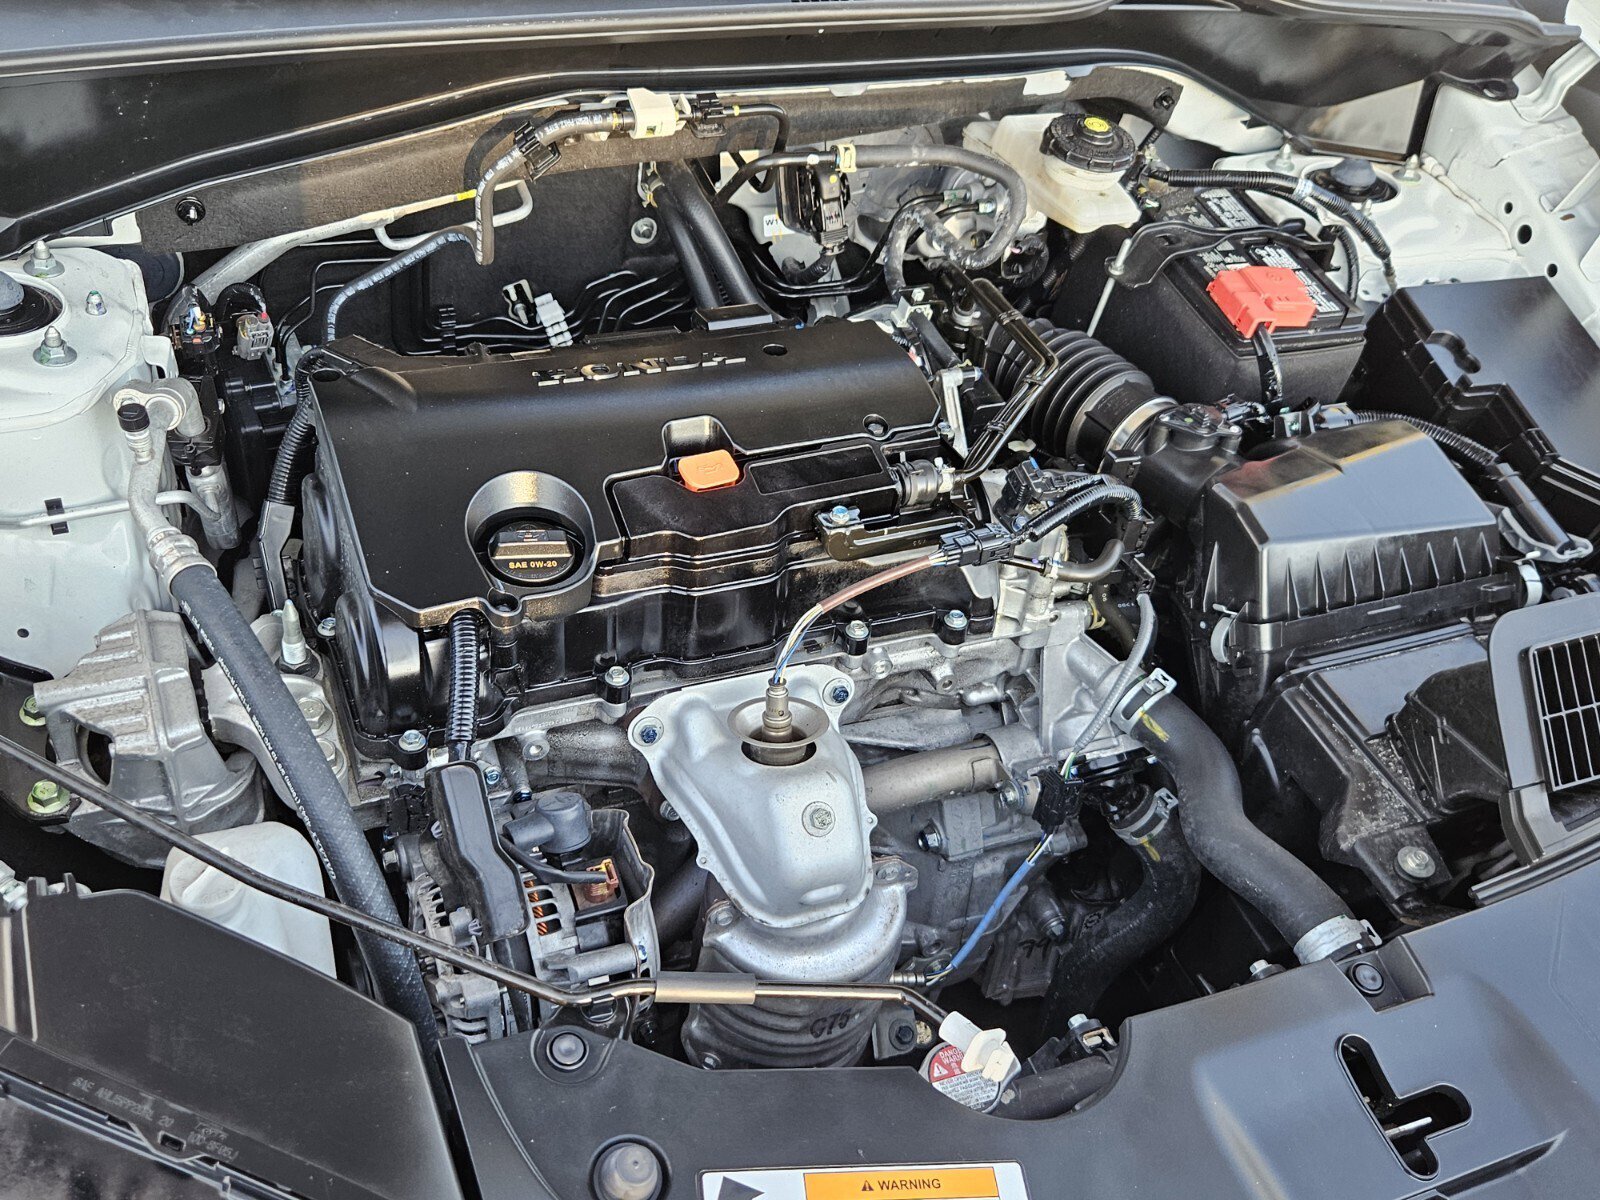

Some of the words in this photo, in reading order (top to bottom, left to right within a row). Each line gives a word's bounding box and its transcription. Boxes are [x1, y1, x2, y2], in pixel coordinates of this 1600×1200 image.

[531, 352, 747, 387] HONDA
[508, 561, 528, 570] SAE
[529, 560, 558, 569] 0W-20
[939, 1047, 961, 1057] DANGE
[877, 1178, 942, 1191] WARNING
